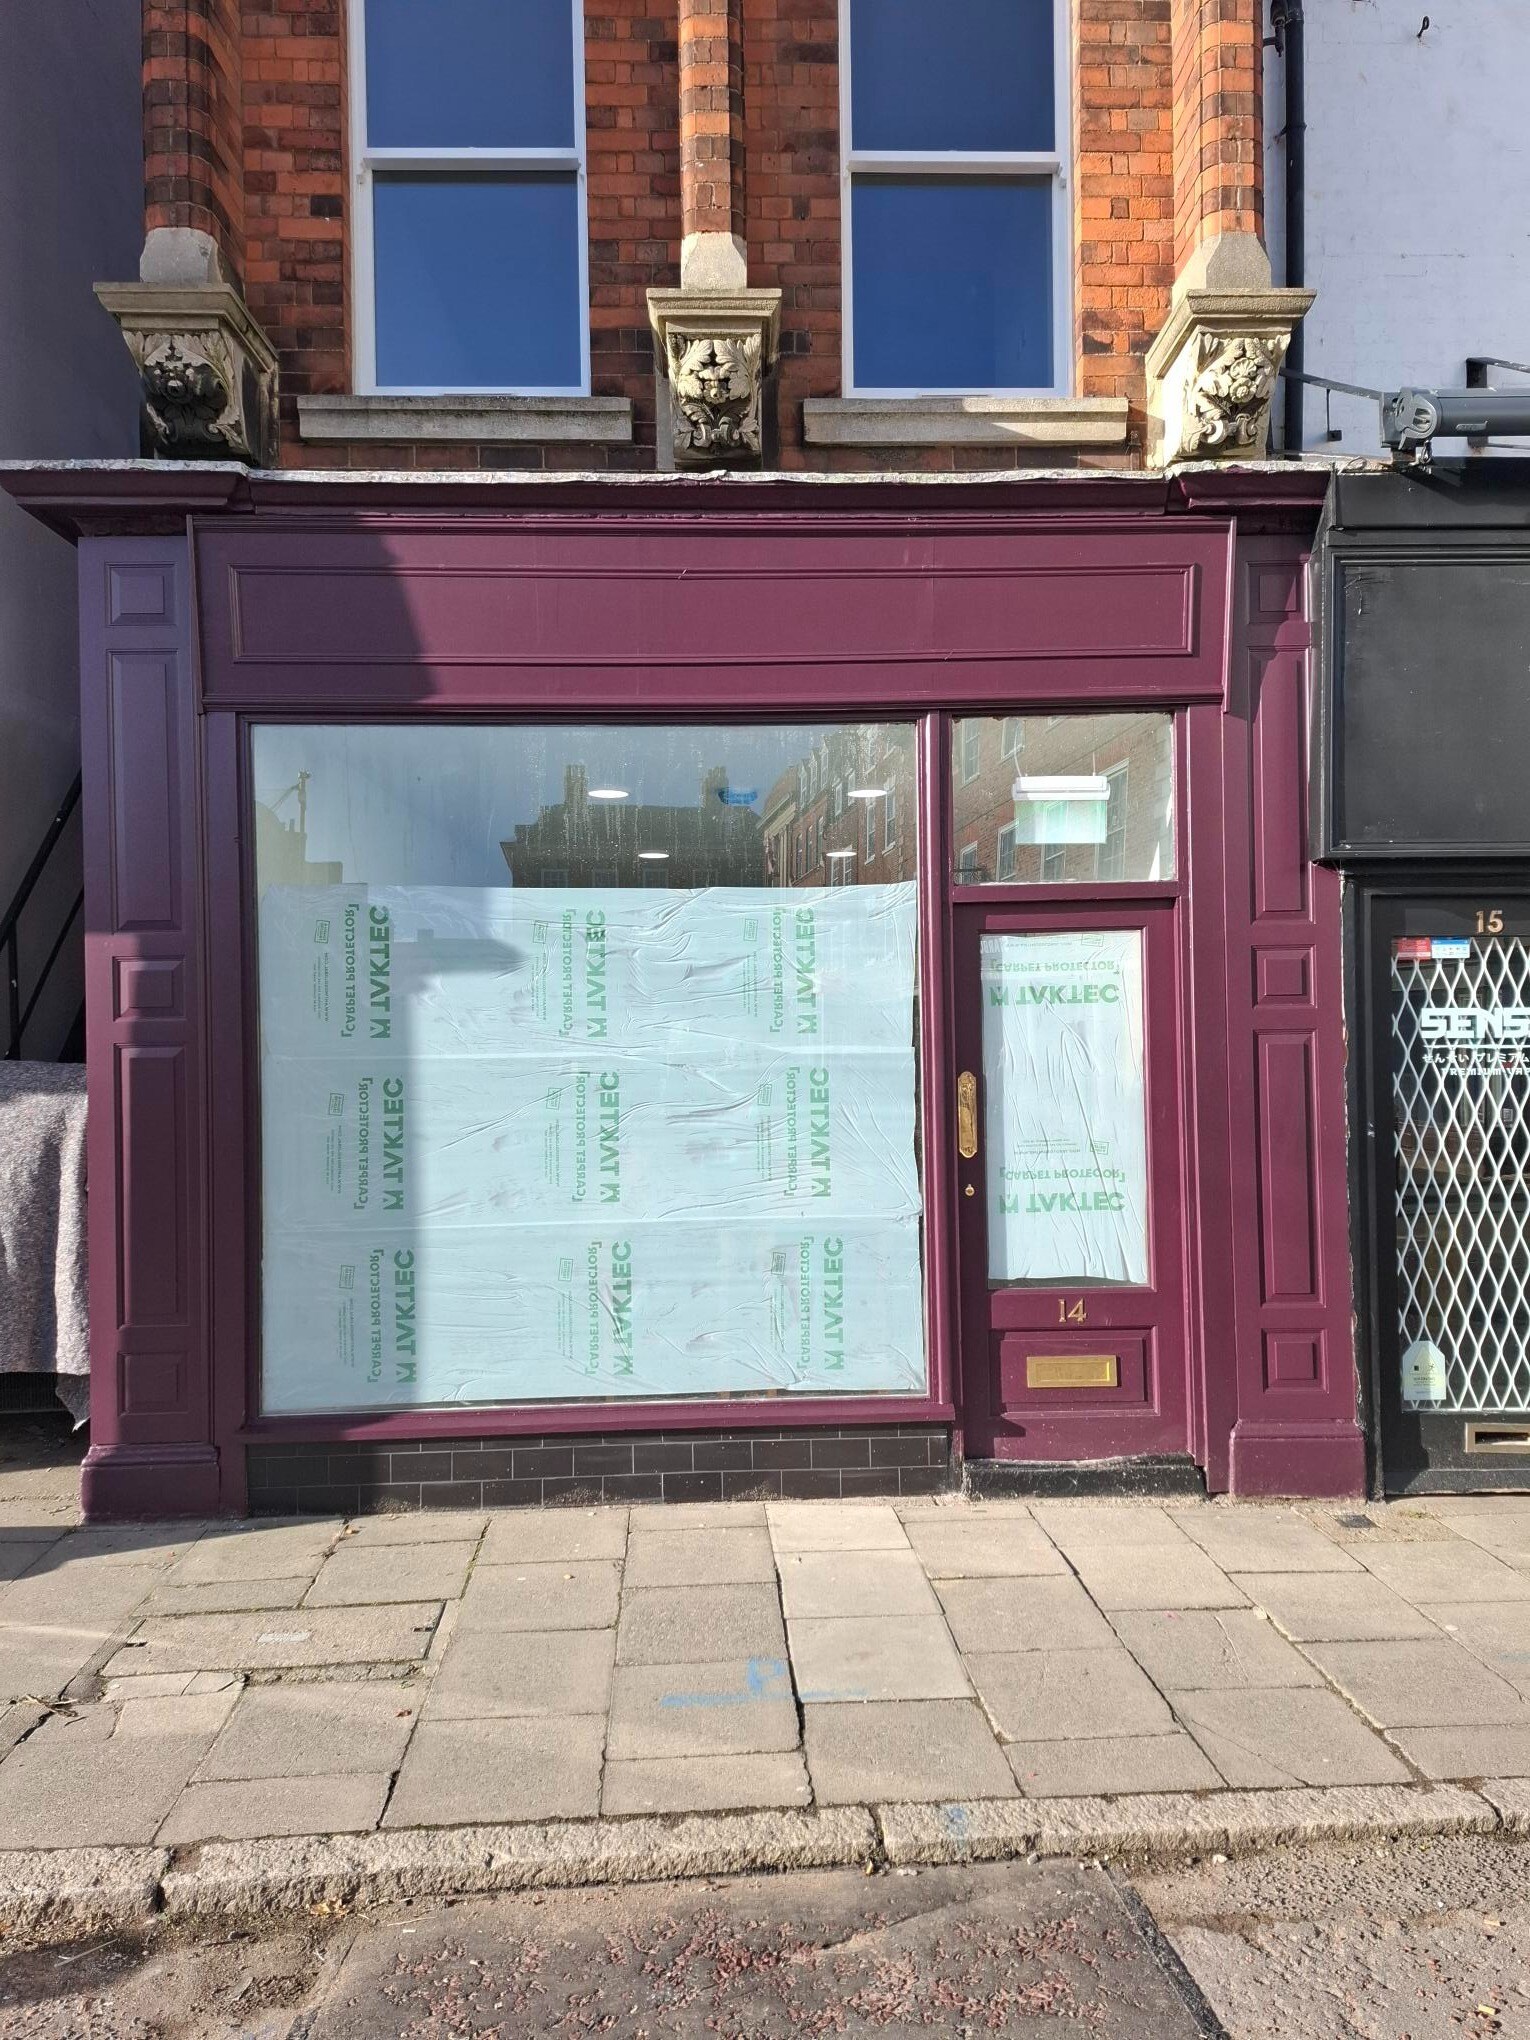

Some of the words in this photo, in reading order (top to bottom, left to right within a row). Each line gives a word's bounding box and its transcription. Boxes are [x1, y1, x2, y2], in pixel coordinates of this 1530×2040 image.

[1475, 909, 1504, 933] 15
[1421, 1007, 1530, 1038] SENS
[1057, 1298, 1088, 1323] 14
